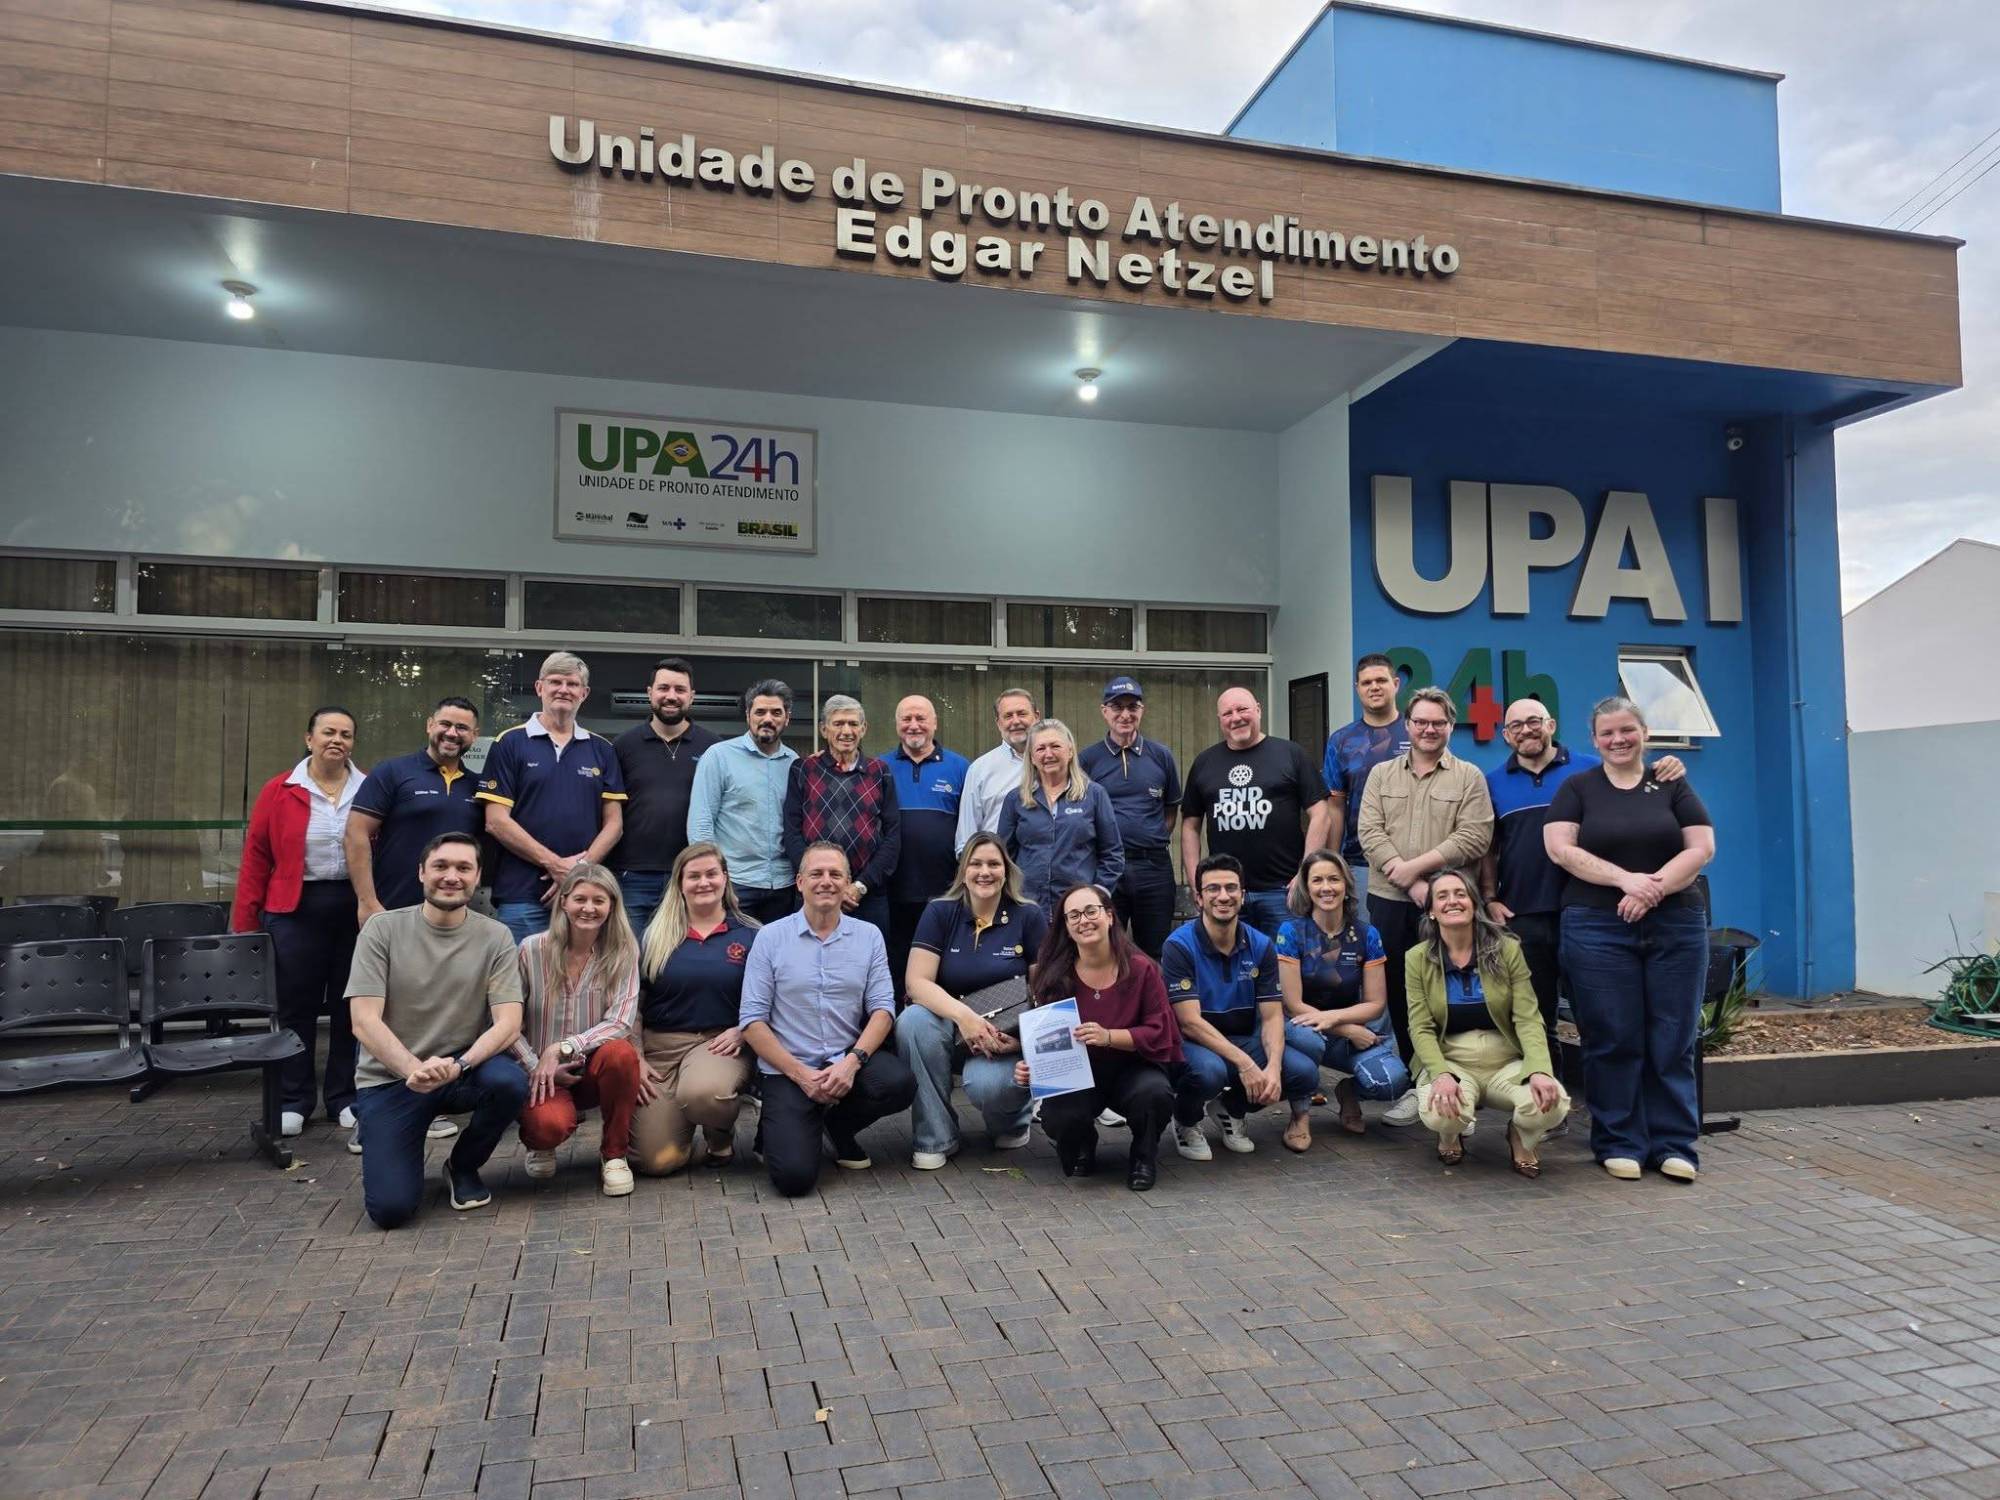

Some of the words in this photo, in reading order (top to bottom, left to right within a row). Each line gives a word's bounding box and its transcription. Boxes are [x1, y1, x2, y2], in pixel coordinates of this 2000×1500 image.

[549, 114, 815, 195] Unidade
[832, 158, 905, 205] de
[922, 168, 1110, 231] Pronto
[1123, 196, 1460, 275] Atendimento
[836, 208, 1044, 276] Edgar
[1066, 236, 1274, 300] Netzel
[578, 474, 635, 491] UNIDADE
[638, 478, 656, 492] DE
[659, 481, 710, 496] PRONTO
[712, 484, 799, 502] ATENDIMENTO
[737, 522, 798, 537] BRASIL
[1371, 474, 1688, 621] UPA
[1218, 786, 1263, 803] END
[1213, 799, 1273, 818] POLIO
[1217, 814, 1268, 832] NOW
